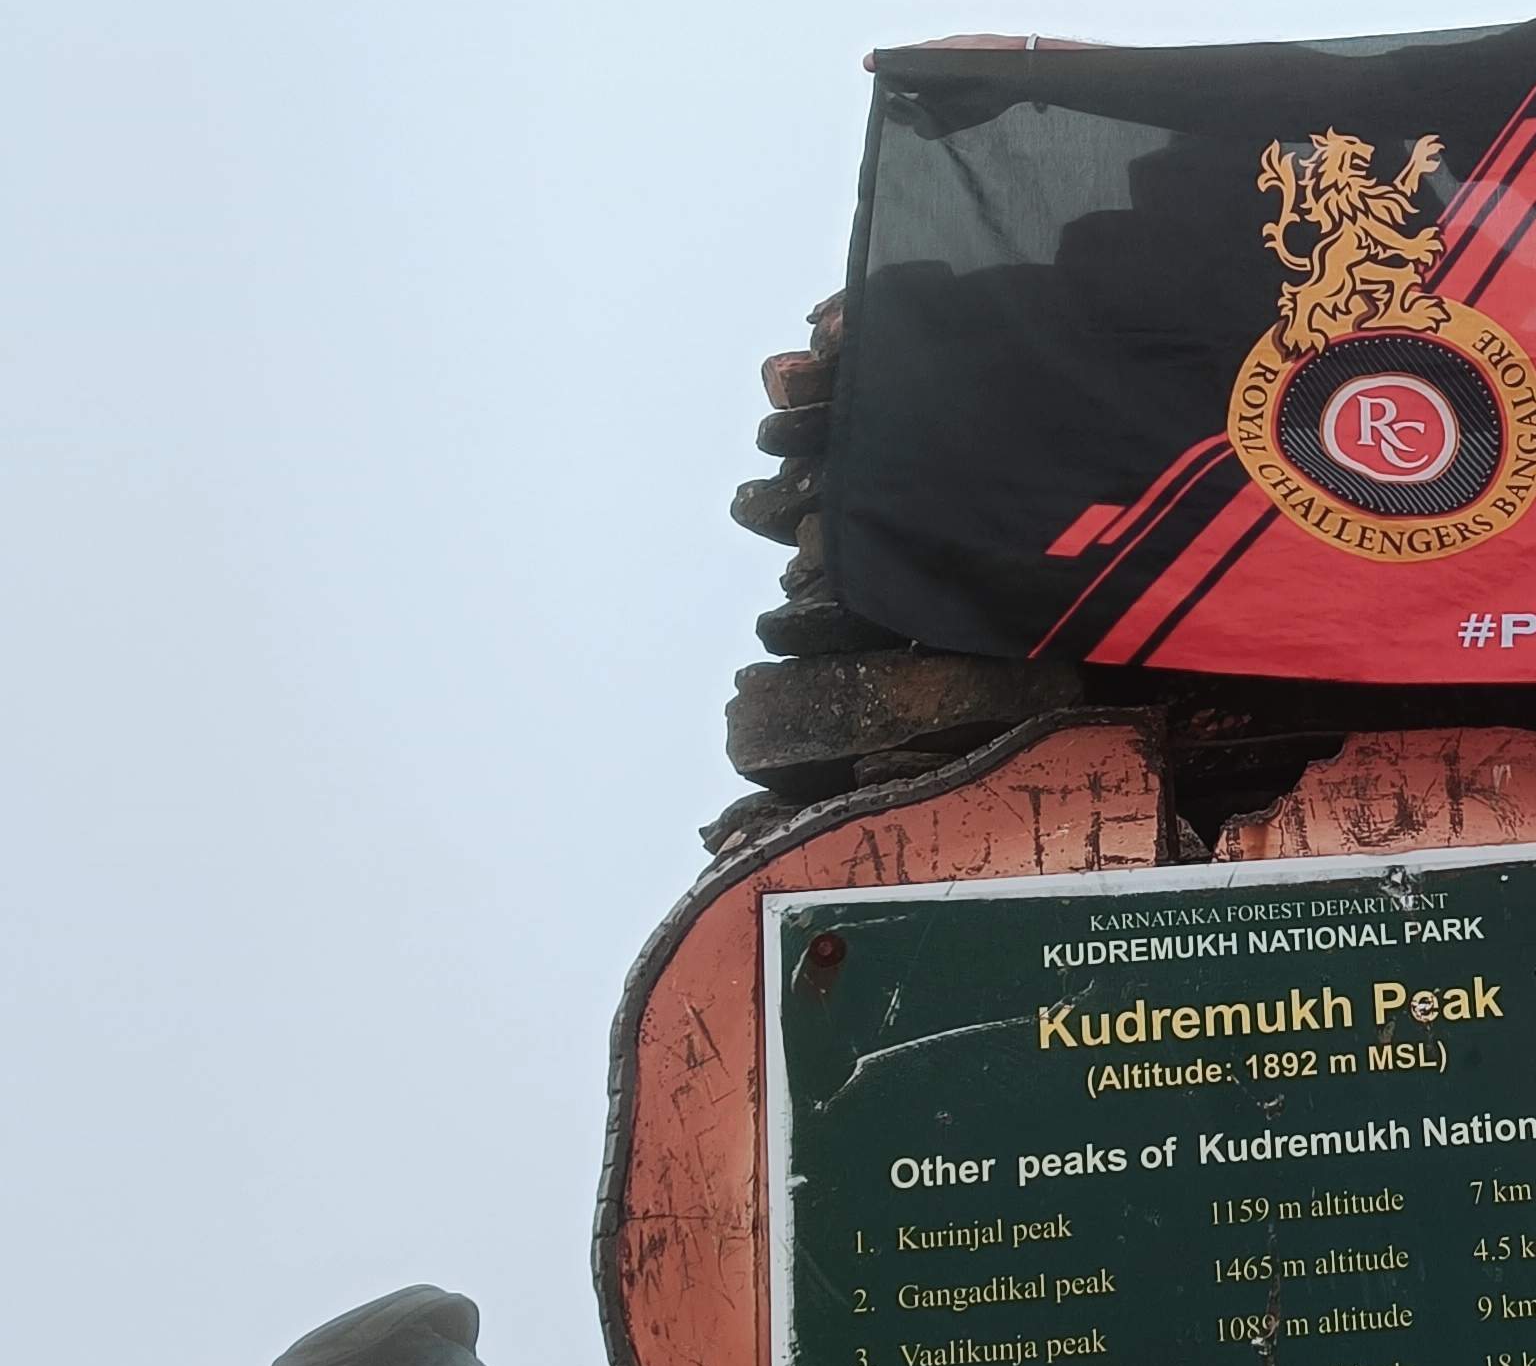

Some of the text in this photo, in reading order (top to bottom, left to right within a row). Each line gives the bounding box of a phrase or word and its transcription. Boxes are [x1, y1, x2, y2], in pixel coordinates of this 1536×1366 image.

[1237, 360, 1279, 455] ROYAL
[1258, 463, 1494, 555] CHALLENGERS
[1089, 905, 1222, 933] KARNATAKA
[1225, 899, 1305, 925] FOREST
[1042, 915, 1486, 969] KUDREMUKH NATIONAL PARK
[1037, 975, 1504, 1050] Kudremukh Peak
[1085, 1041, 1449, 1099] (Altitude: 1892 m MSL)
[889, 1153, 997, 1189] Other
[1016, 1141, 1129, 1187] peaks
[1138, 1135, 1178, 1170] of
[1197, 1117, 1411, 1167] Kudremukh
[1211, 1187, 1405, 1225] 1159 m altitude
[1469, 1180, 1484, 1205] 7
[1492, 1179, 1532, 1203] km
[855, 1213, 1073, 1254] 1. Kurinjal peak
[1473, 1237, 1511, 1262] 4.5
[1215, 1245, 1409, 1283] 1465 m altitude
[853, 1268, 1116, 1313] 2. Gangadikal peak
[1477, 1296, 1493, 1321] 9
[1217, 1303, 1413, 1342] 1089 m altitude
[900, 1334, 1038, 1366] Vaalikunja
[1047, 1329, 1107, 1363] peak
